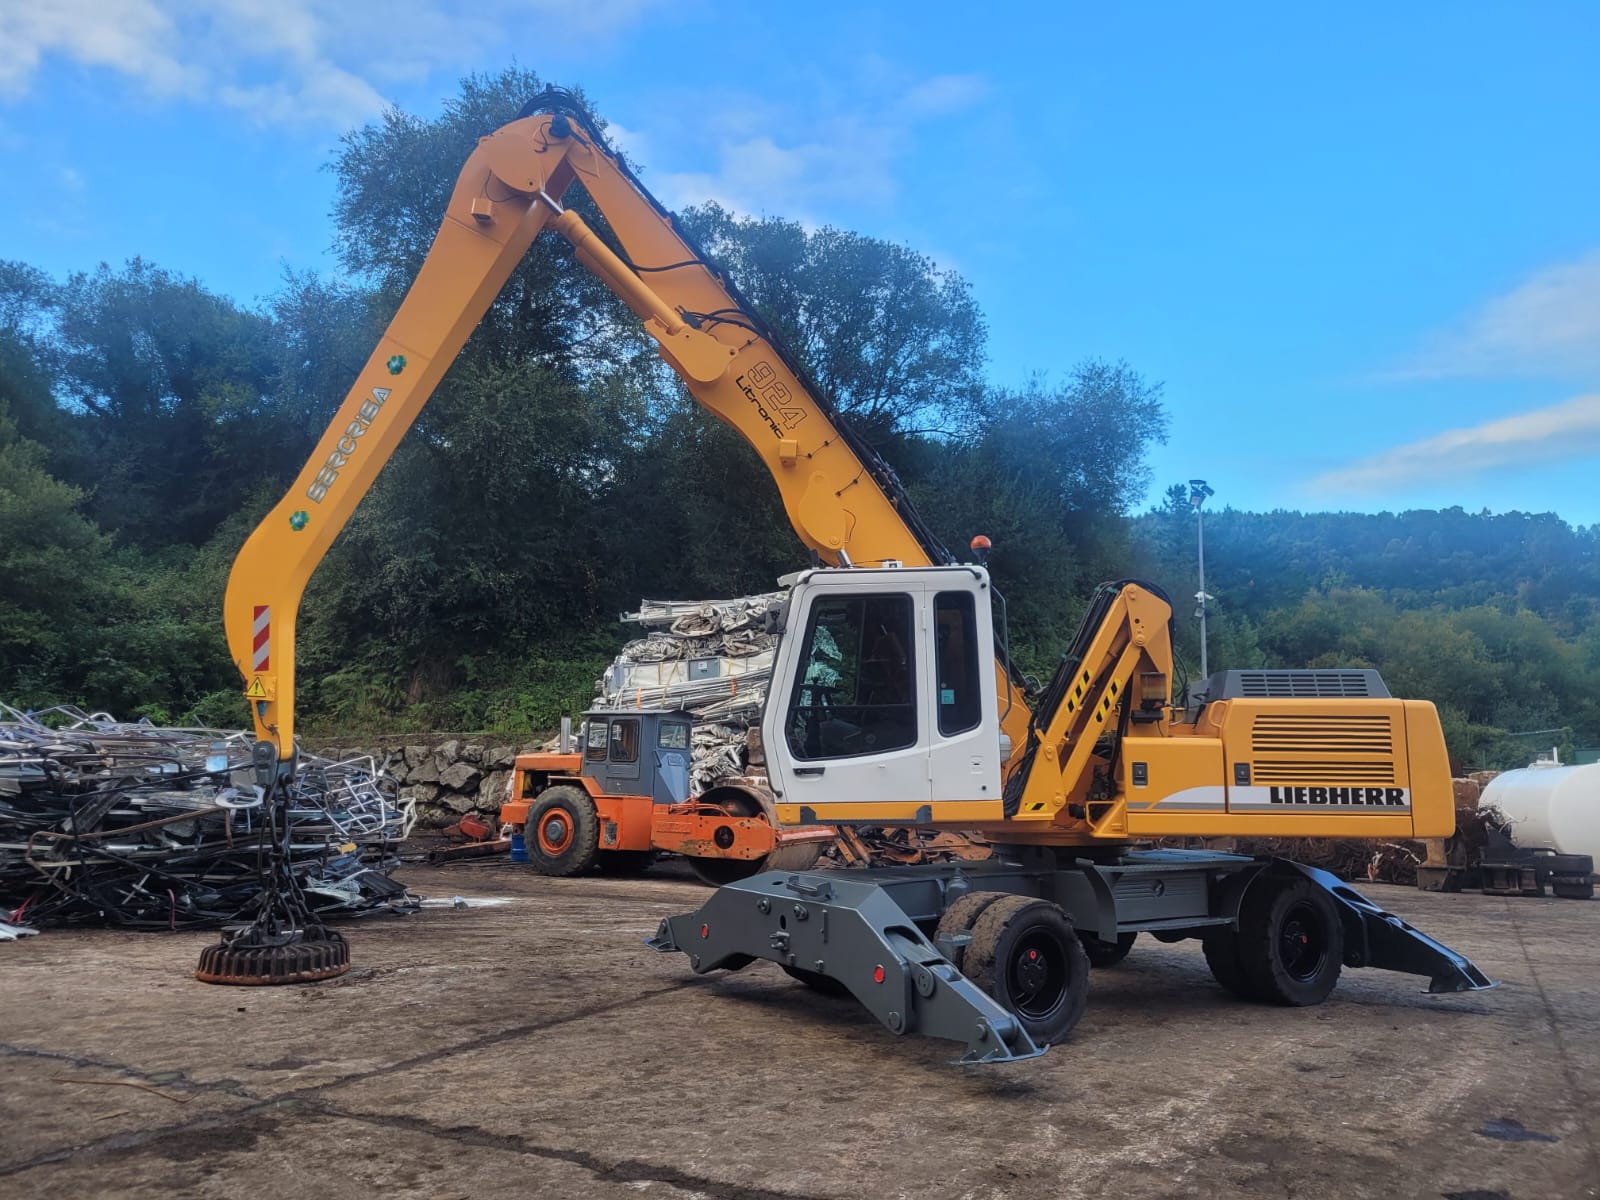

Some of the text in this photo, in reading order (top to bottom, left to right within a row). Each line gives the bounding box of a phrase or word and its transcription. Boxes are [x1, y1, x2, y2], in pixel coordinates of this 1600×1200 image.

[735, 375, 785, 440] Litronic
[747, 361, 808, 430] 924
[1270, 787, 1405, 806] LIEBHERR
